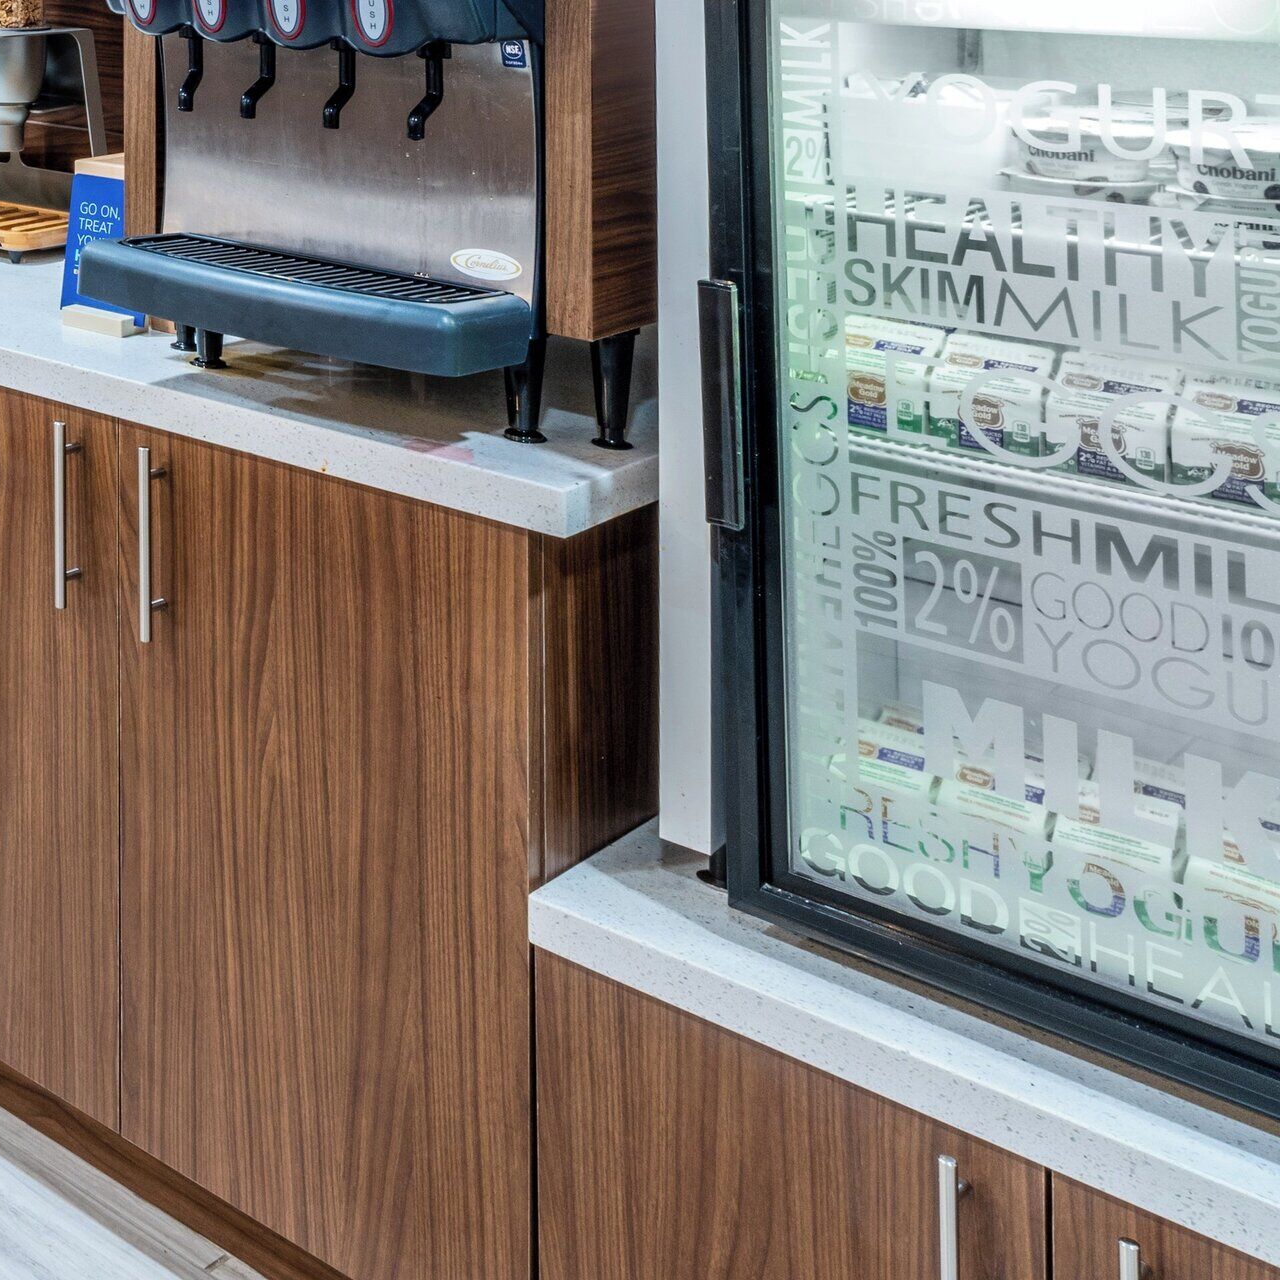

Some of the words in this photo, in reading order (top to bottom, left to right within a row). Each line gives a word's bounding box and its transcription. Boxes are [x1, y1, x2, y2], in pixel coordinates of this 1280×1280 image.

[780, 21, 833, 129] MILK
[78, 216, 114, 235] TREAT
[79, 201, 98, 216] GO
[100, 204, 121, 221] ON,
[845, 184, 1233, 299] HEALTHY
[851, 530, 898, 630] 100%
[914, 550, 1016, 654] 2%
[1030, 571, 1210, 653] GOOD
[799, 826, 1010, 936] GOOD
